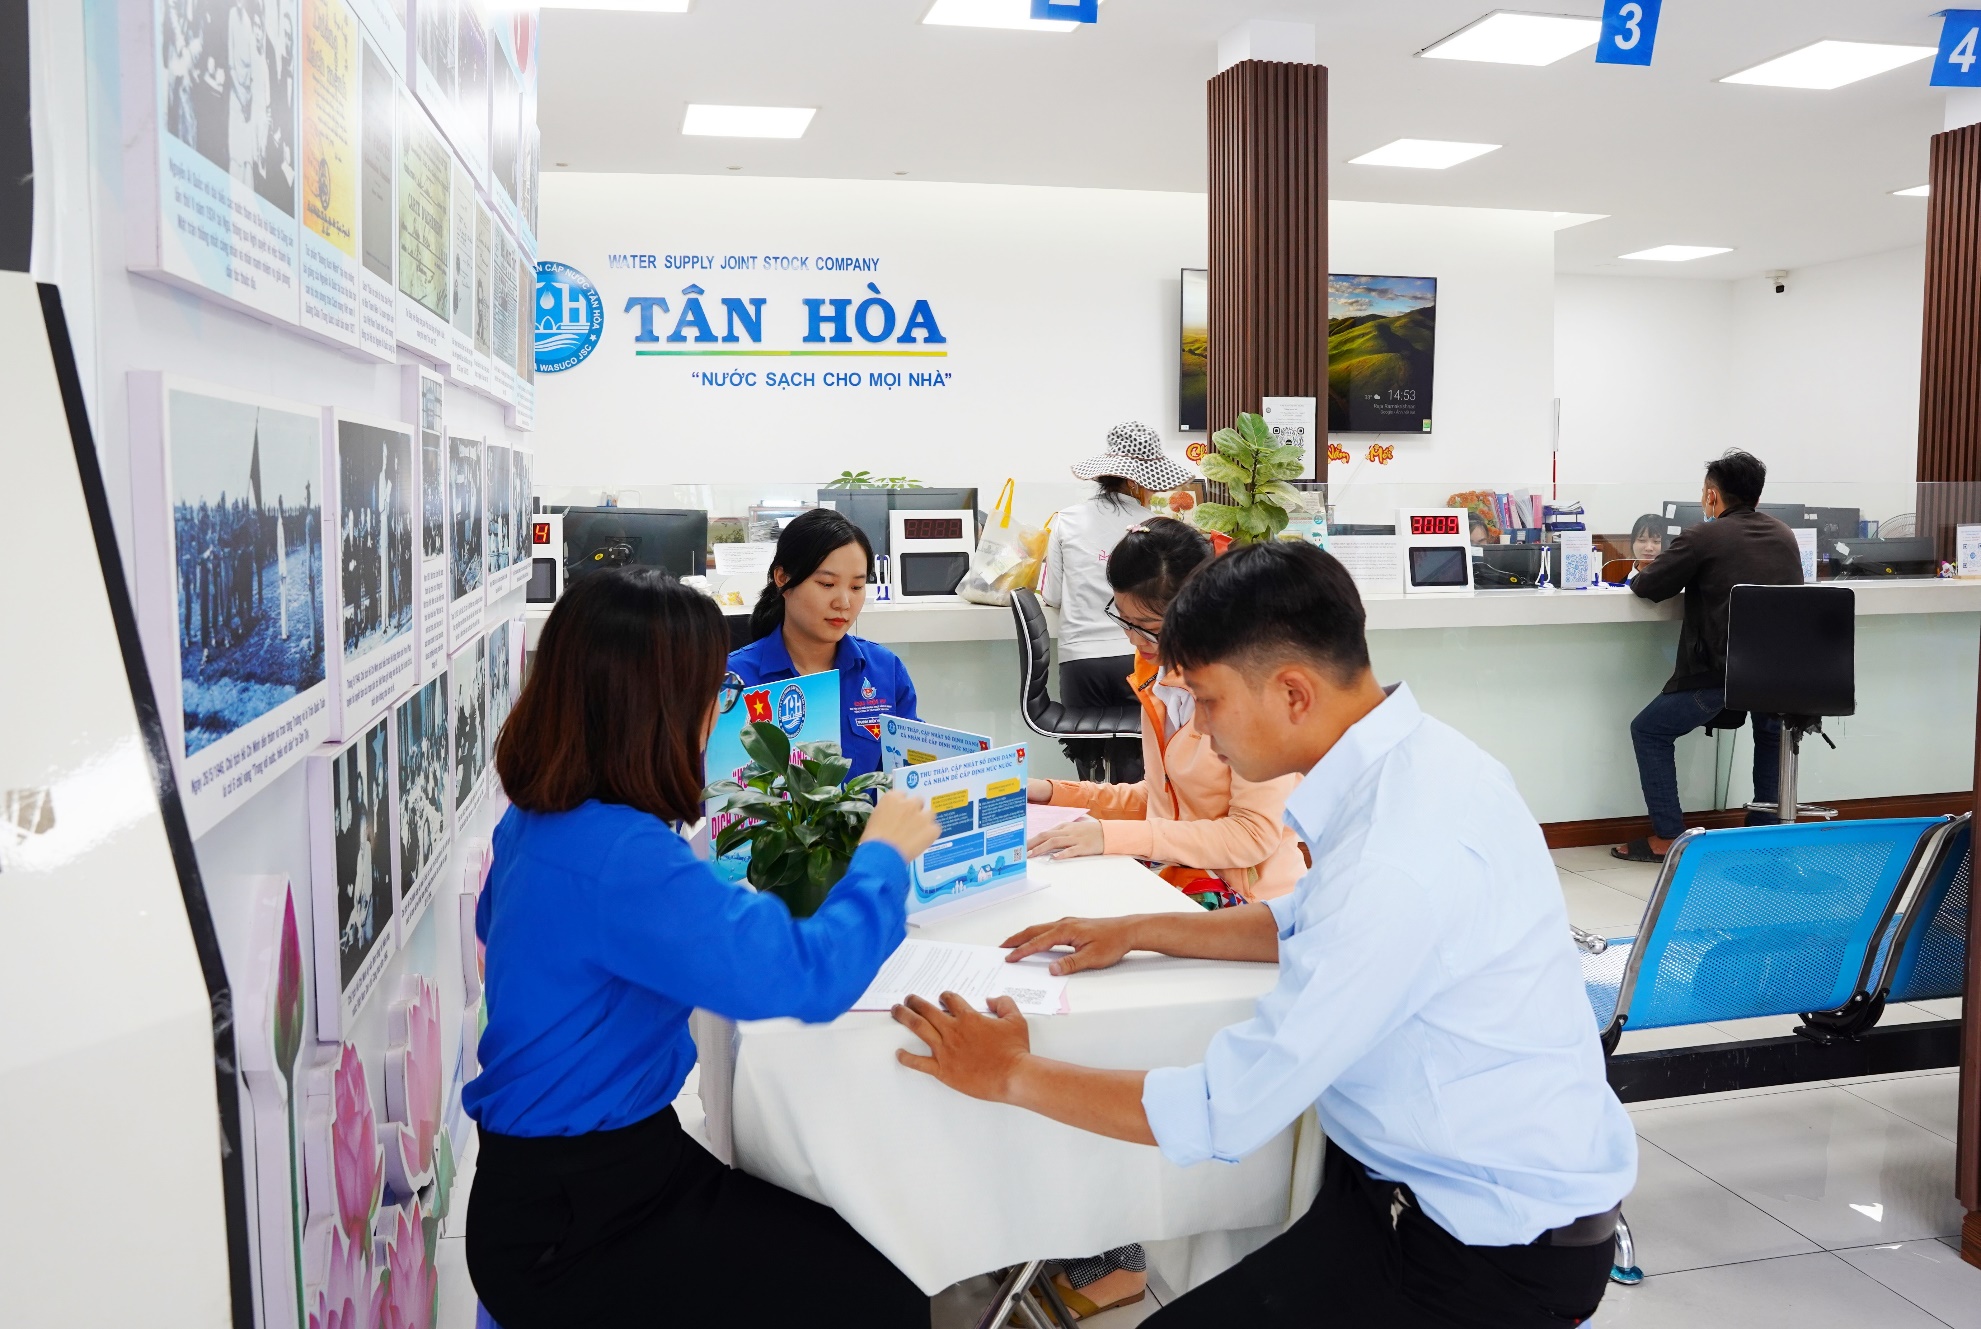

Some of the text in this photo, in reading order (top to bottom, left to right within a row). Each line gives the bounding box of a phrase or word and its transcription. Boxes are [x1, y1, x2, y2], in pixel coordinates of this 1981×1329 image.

[1614, 2, 1643, 51] 3
[1948, 26, 1980, 73] 4
[608, 255, 880, 272] WATER SUPPLY JOINT STOCK COMPANY
[623, 281, 947, 344] TÂN HÒA
[540, 356, 578, 372] WASUCO
[578, 344, 592, 360] JSC
[765, 371, 816, 390] SẠCH
[823, 371, 862, 387] CHO
[869, 371, 902, 391] MỌI
[1388, 389, 1416, 401] 14:53
[1368, 443, 1394, 465] Mới
[1412, 517, 1458, 534] 3009
